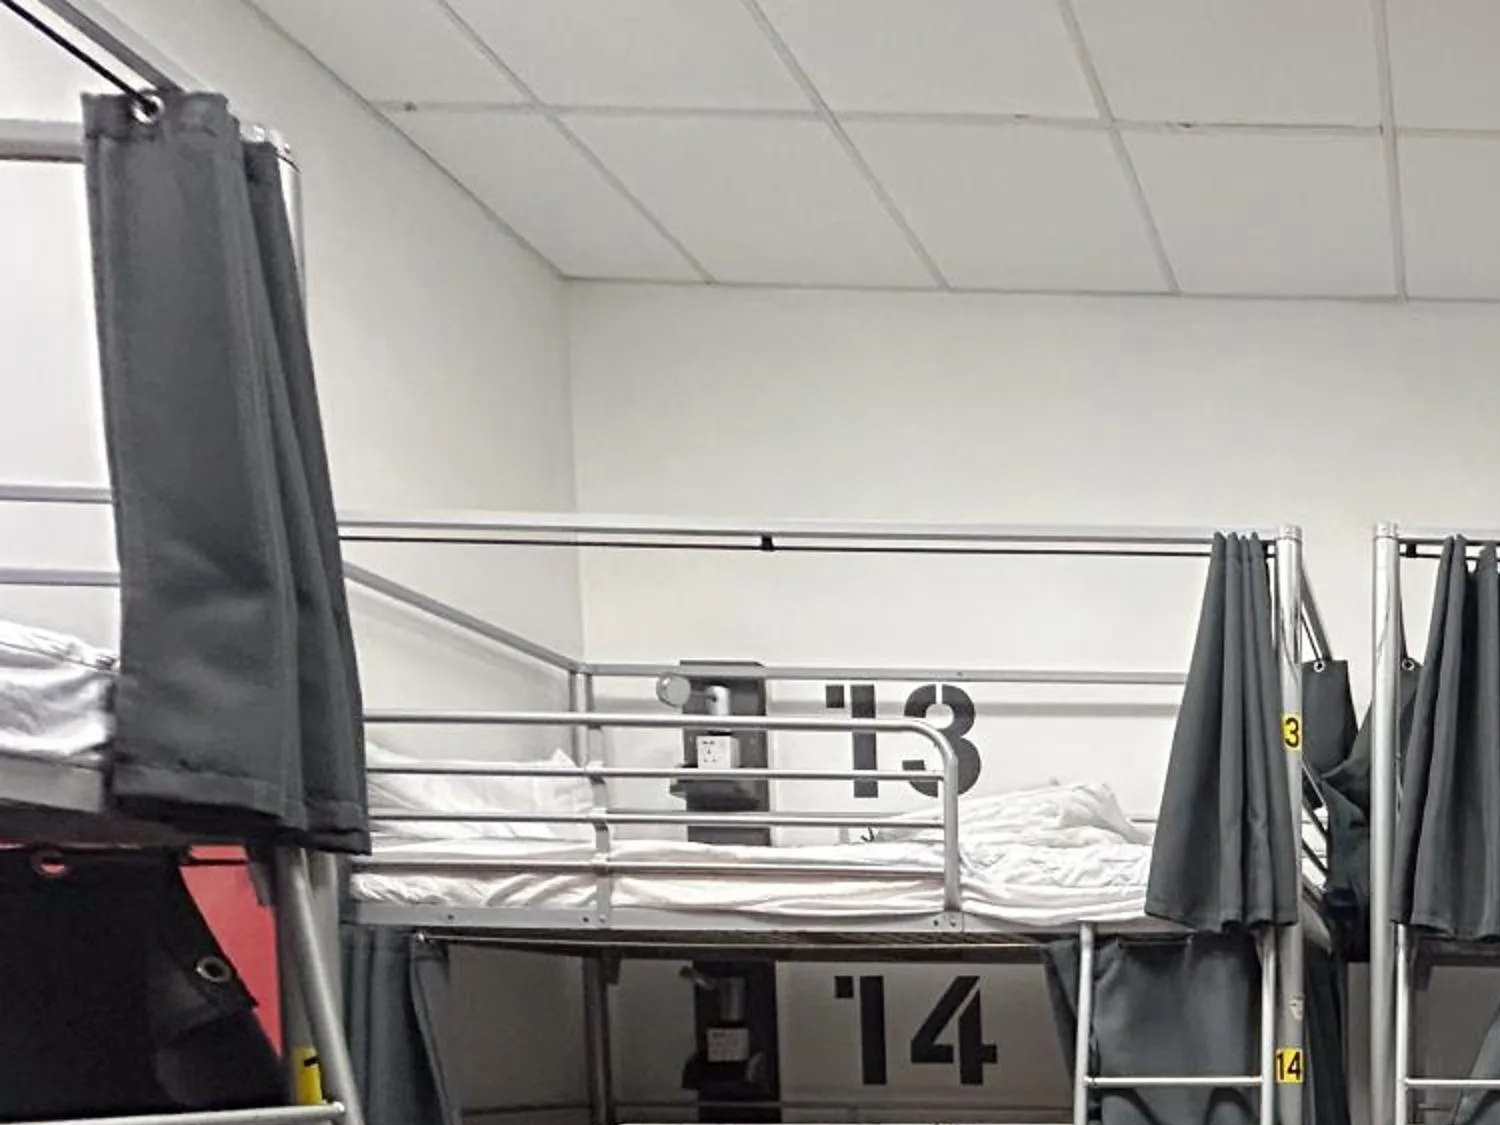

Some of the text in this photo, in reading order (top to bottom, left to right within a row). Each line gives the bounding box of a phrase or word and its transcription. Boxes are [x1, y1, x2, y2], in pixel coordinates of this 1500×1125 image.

[825, 684, 981, 798] 13
[834, 976, 997, 1085] 14
[1277, 1051, 1301, 1081] 14
